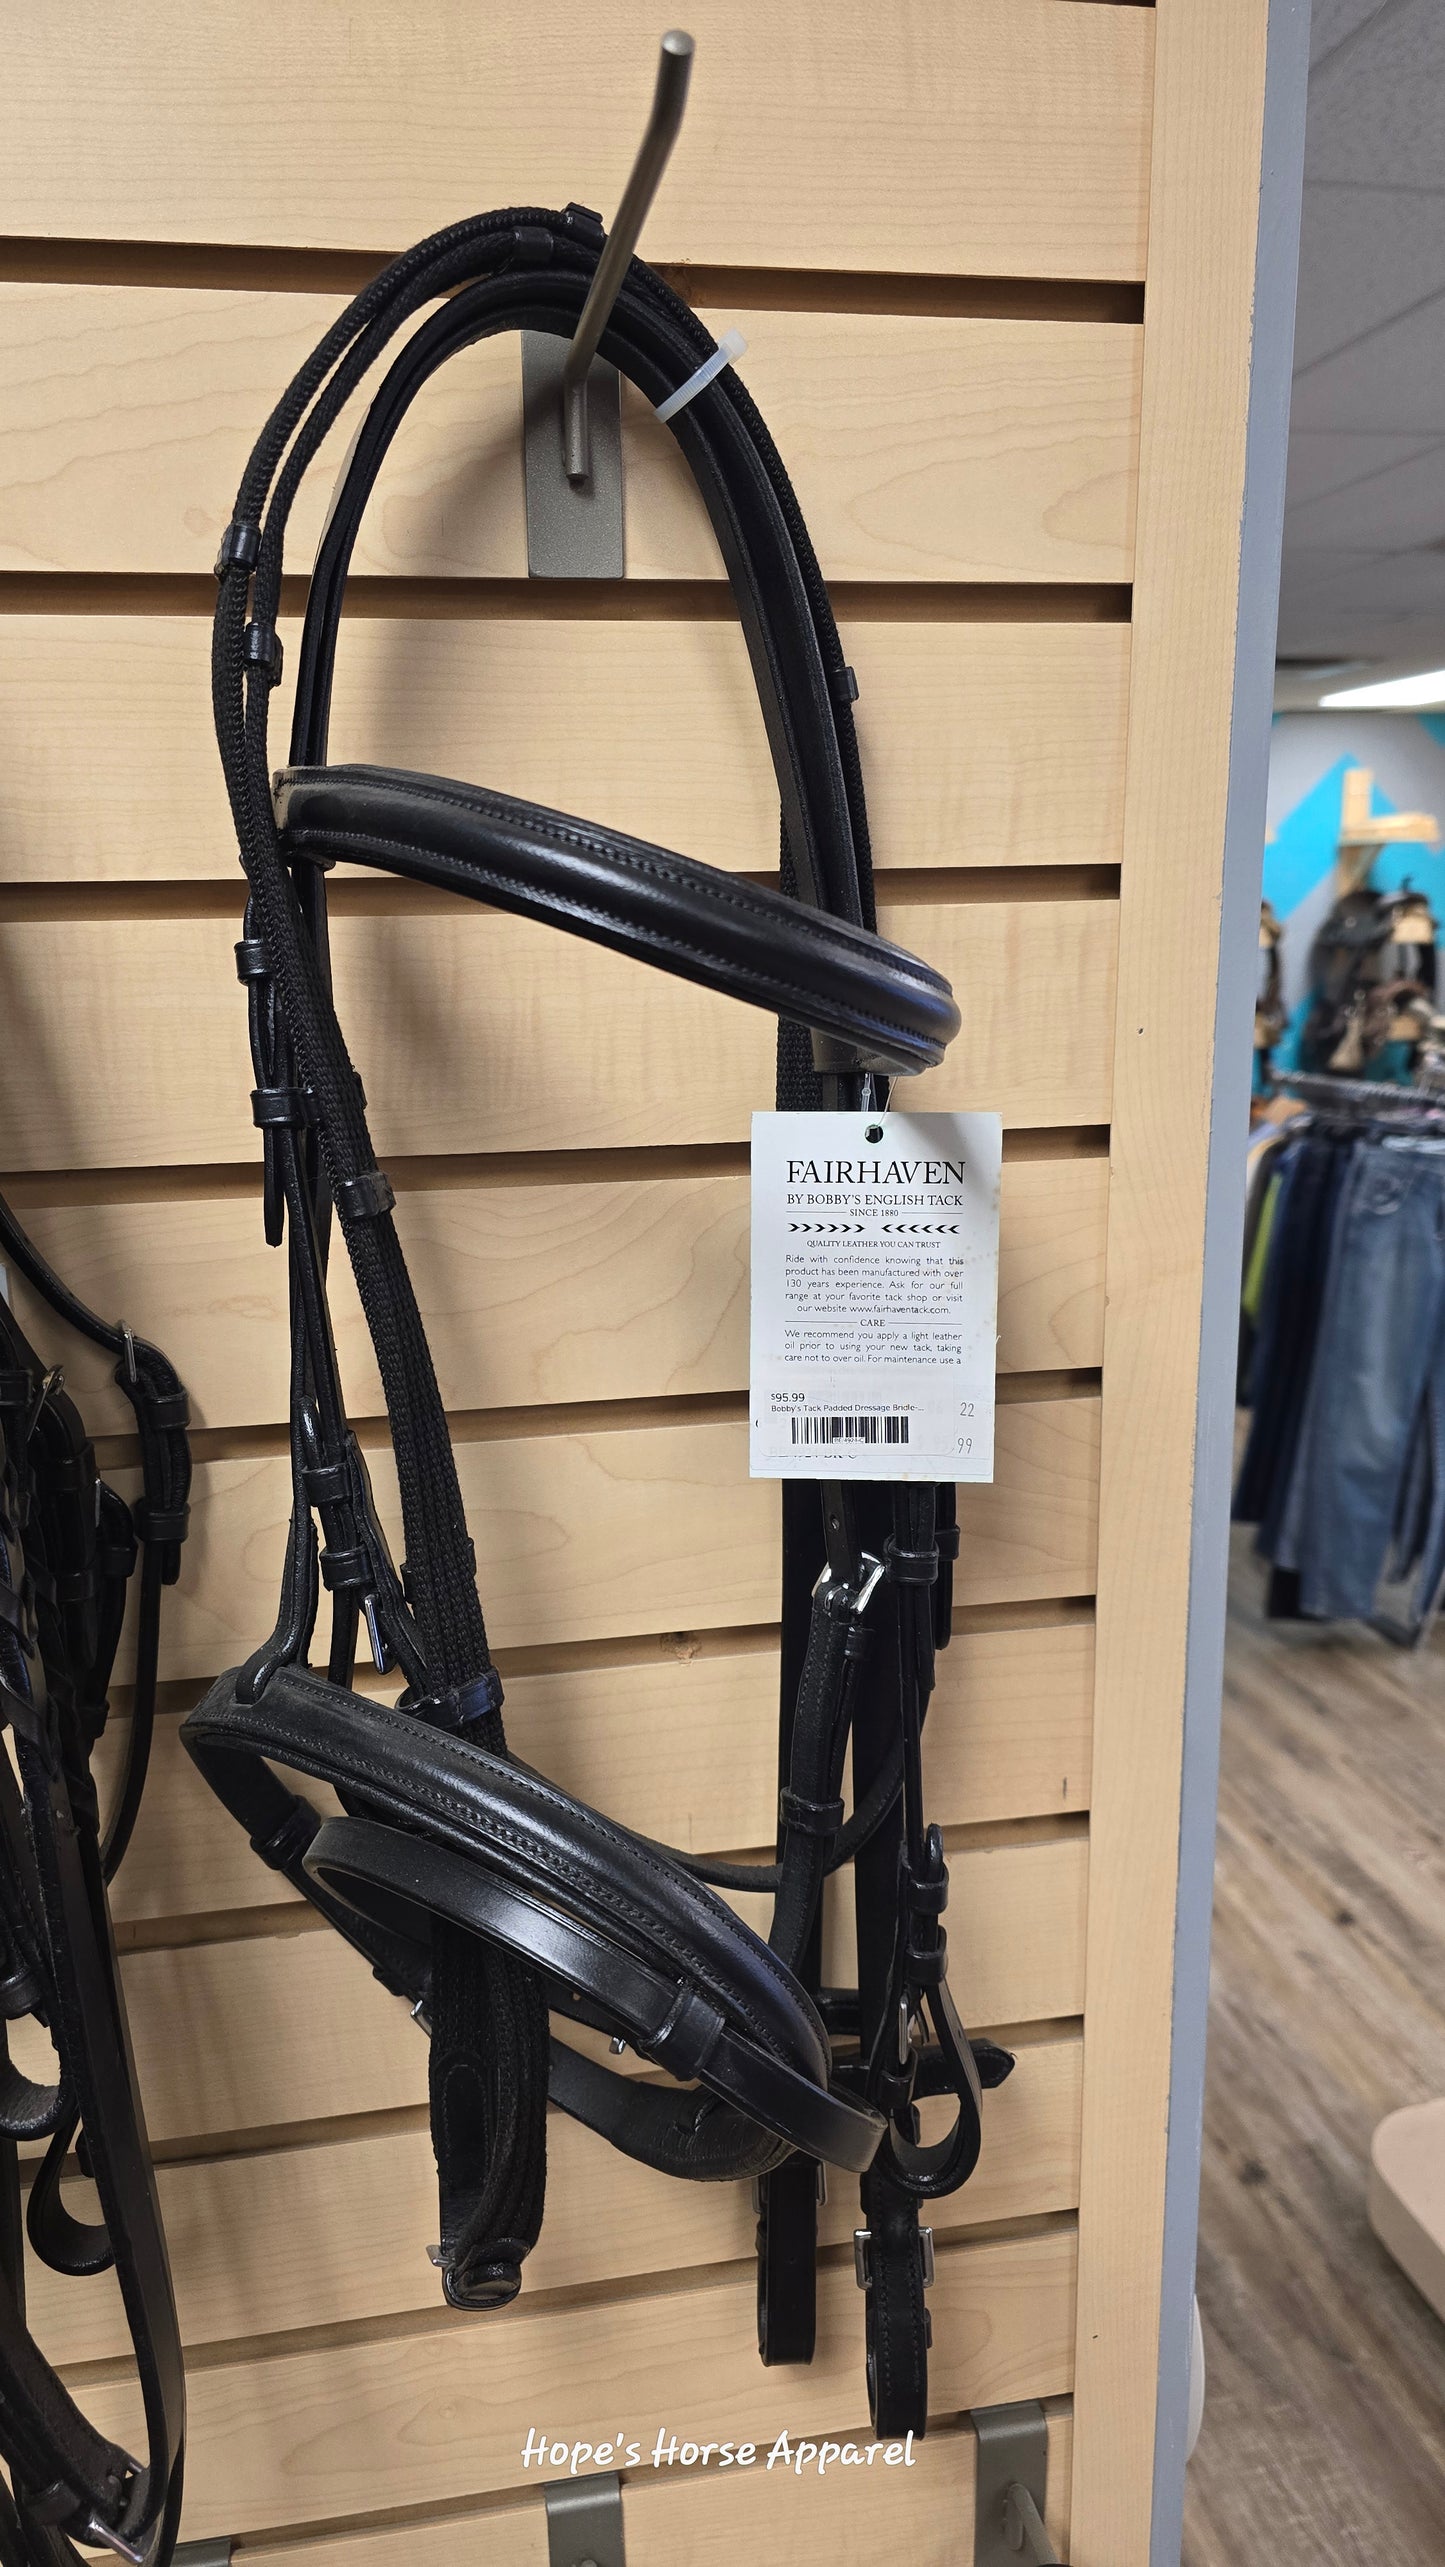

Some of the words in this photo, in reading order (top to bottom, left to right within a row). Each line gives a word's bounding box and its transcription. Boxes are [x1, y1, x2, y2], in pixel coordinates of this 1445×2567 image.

[786, 1160, 966, 1184] FAIRHAVEN
[787, 1194, 803, 1205] BY
[807, 1194, 861, 1205] BOBBY'S
[866, 1195, 924, 1205] ENGLISH
[927, 1195, 963, 1206] TACK
[881, 1209, 898, 1217] 1880
[807, 1240, 841, 1248] QUALITY
[786, 1255, 804, 1263] Ride
[810, 1255, 828, 1263] with
[834, 1256, 879, 1264] confidence
[885, 1256, 921, 1266] knowing
[927, 1257, 943, 1265] that
[949, 1257, 964, 1265] this
[786, 1268, 819, 1276] product
[822, 1268, 835, 1276] has
[838, 1268, 859, 1276] been
[862, 1269, 919, 1277] manufactured
[923, 1269, 941, 1277] with
[786, 1279, 801, 1287] 130
[807, 1281, 829, 1289] years
[835, 1281, 884, 1290] experience.
[889, 1281, 905, 1289] Ask
[911, 1281, 924, 1289] for
[950, 1282, 963, 1290] full
[786, 1294, 808, 1302] range
[825, 1294, 844, 1302] your
[849, 1293, 880, 1301] favorite
[907, 1294, 927, 1303] shop
[850, 1305, 951, 1314] www.fairhaventack.com.
[861, 1319, 885, 1327] CARE
[858, 1333, 873, 1341] you
[877, 1332, 899, 1341] apply
[911, 1332, 928, 1341] light
[800, 1343, 820, 1351] prior
[840, 1343, 861, 1352] using
[937, 1344, 962, 1353] taking
[867, 1355, 882, 1363] For
[884, 1356, 937, 1364] maintenance
[771, 1393, 805, 1402] $95.99
[771, 1405, 801, 1413] Bobby's
[960, 1402, 974, 1417] 22
[958, 1438, 973, 1453] 99
